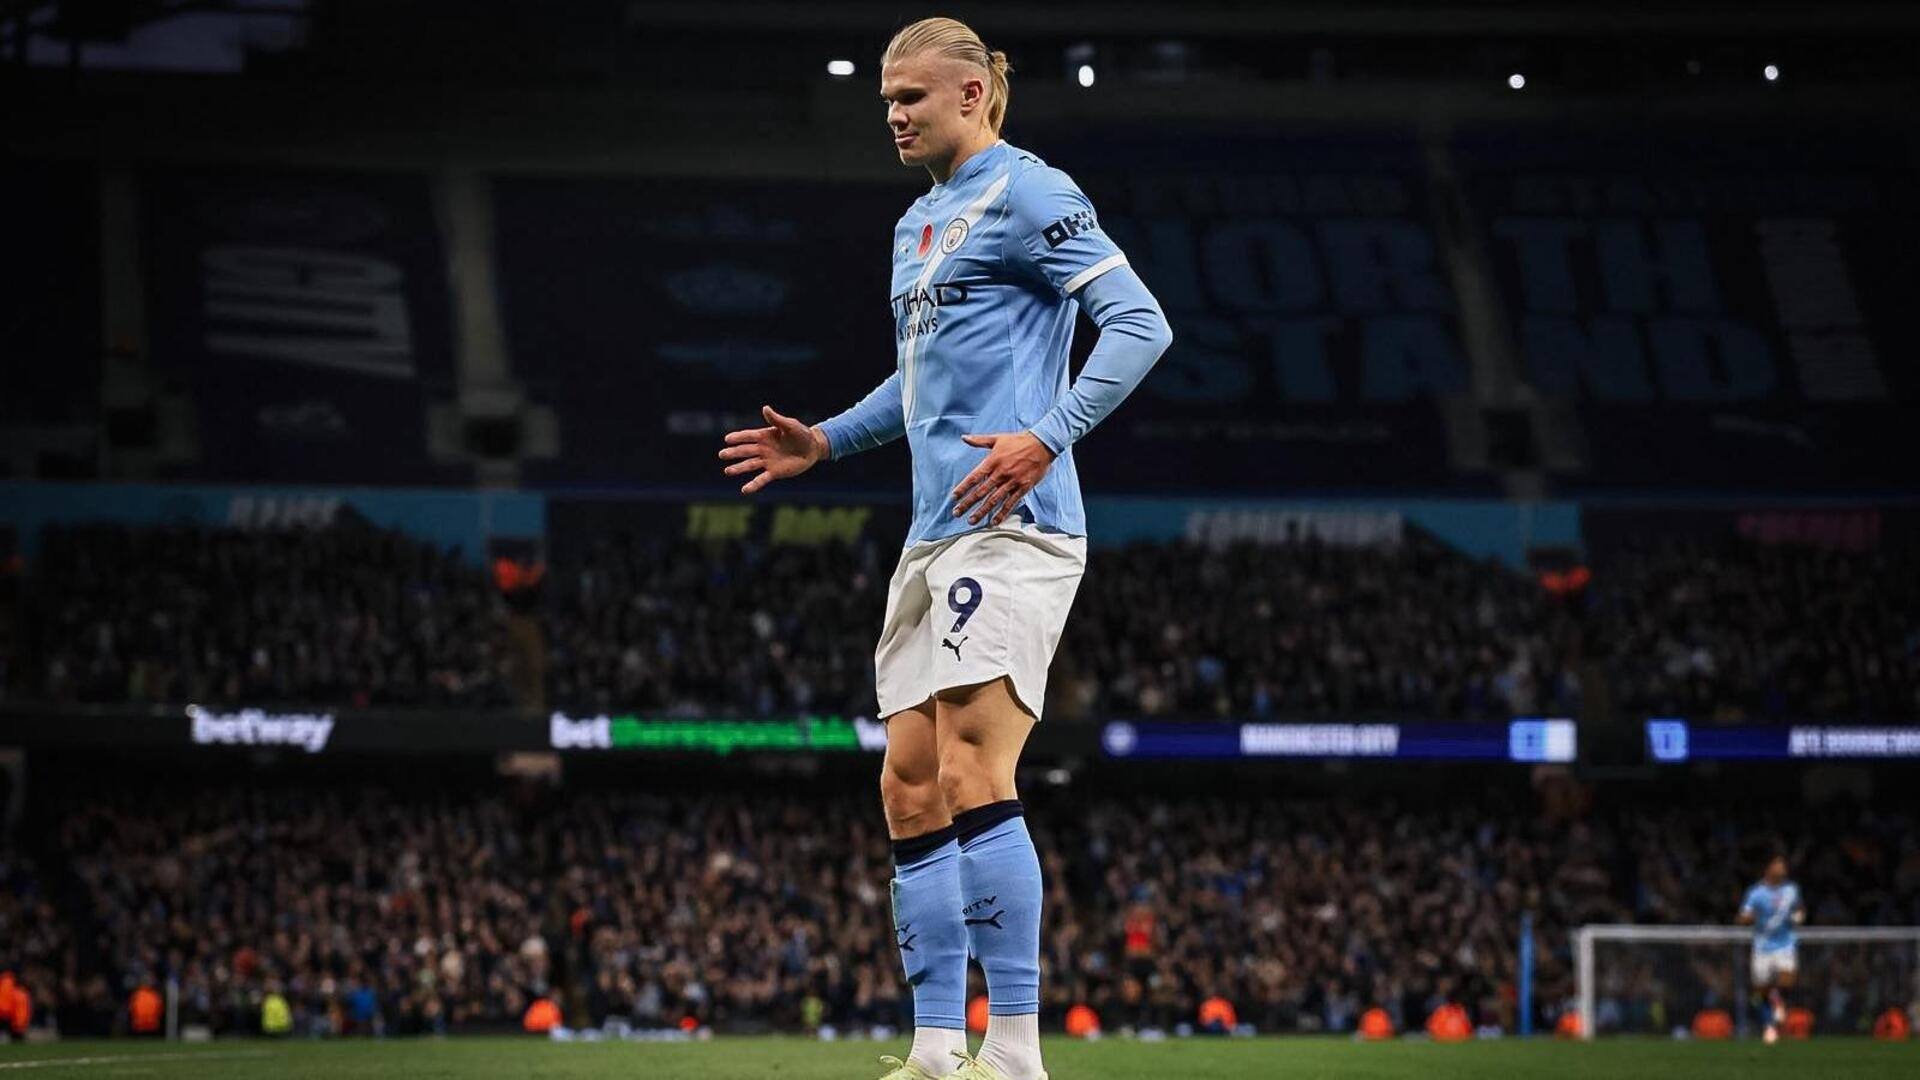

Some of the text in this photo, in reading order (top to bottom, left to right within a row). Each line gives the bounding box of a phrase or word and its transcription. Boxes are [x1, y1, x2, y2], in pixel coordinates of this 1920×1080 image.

[891, 281, 968, 318] TIHAD
[898, 317, 939, 342] AIRWAYS
[948, 577, 982, 632] 9
[193, 708, 334, 752] betway
